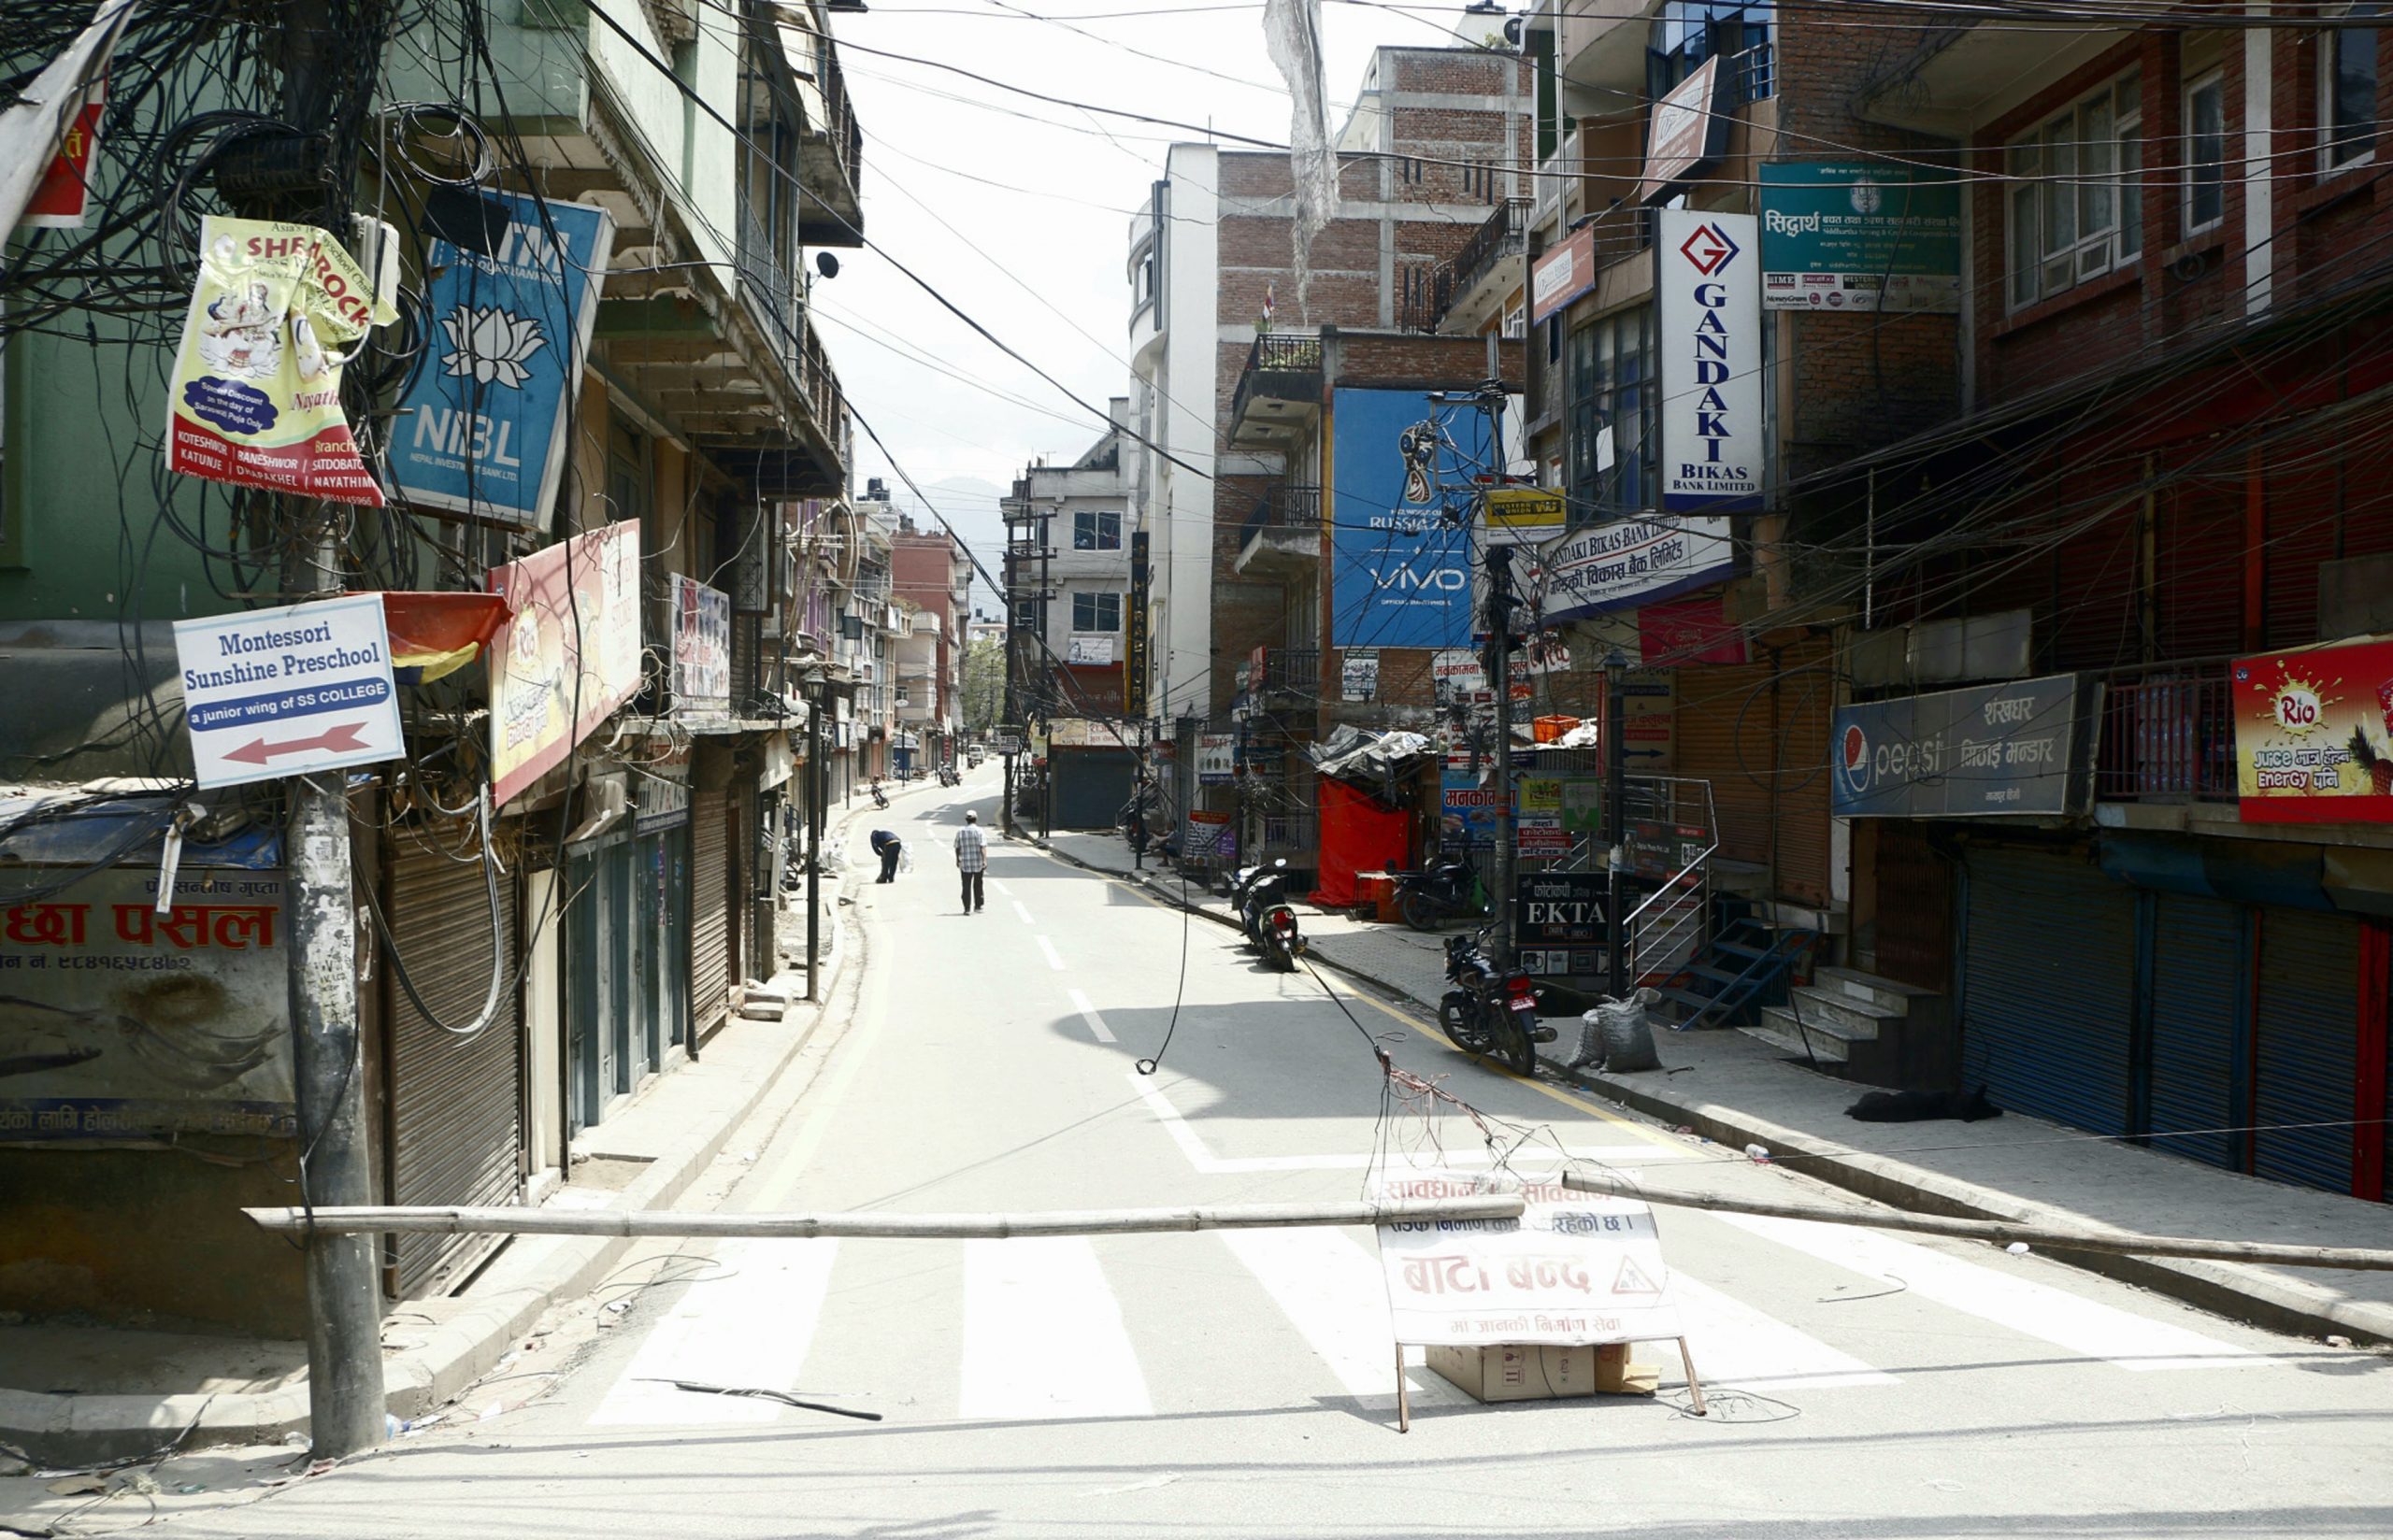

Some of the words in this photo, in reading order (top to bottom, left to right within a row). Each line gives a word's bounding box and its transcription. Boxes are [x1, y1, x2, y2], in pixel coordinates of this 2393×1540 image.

[1693, 282, 1732, 463] GANDAKI
[226, 388, 265, 406] Discount
[228, 400, 244, 414] day
[244, 405, 255, 414] of
[413, 403, 521, 468] NIBL
[180, 448, 223, 472] KATUNJE
[236, 449, 298, 470] BANESHWOR
[409, 451, 435, 466] NEPAL
[1680, 463, 1748, 481] BIKAS
[1672, 479, 1706, 492] BANK
[1707, 479, 1755, 493] LIMITED
[1589, 529, 1623, 557] BIKAS
[1368, 561, 1467, 591] vivo
[1586, 563, 1626, 587] विकास
[218, 620, 332, 657] Montessori
[184, 661, 279, 692] Sunshine
[282, 641, 381, 677] Preschool
[191, 712, 201, 724] a
[202, 704, 242, 726] junior
[244, 700, 279, 717] wing
[280, 695, 295, 710] of
[296, 692, 317, 707] SS
[319, 681, 387, 705] COLLEGE
[1874, 731, 1942, 786] pepsi
[2313, 766, 2339, 790] पनि
[238, 880, 279, 898] गुप्ता
[1526, 901, 1608, 925] EKTA
[111, 903, 279, 948] पसल
